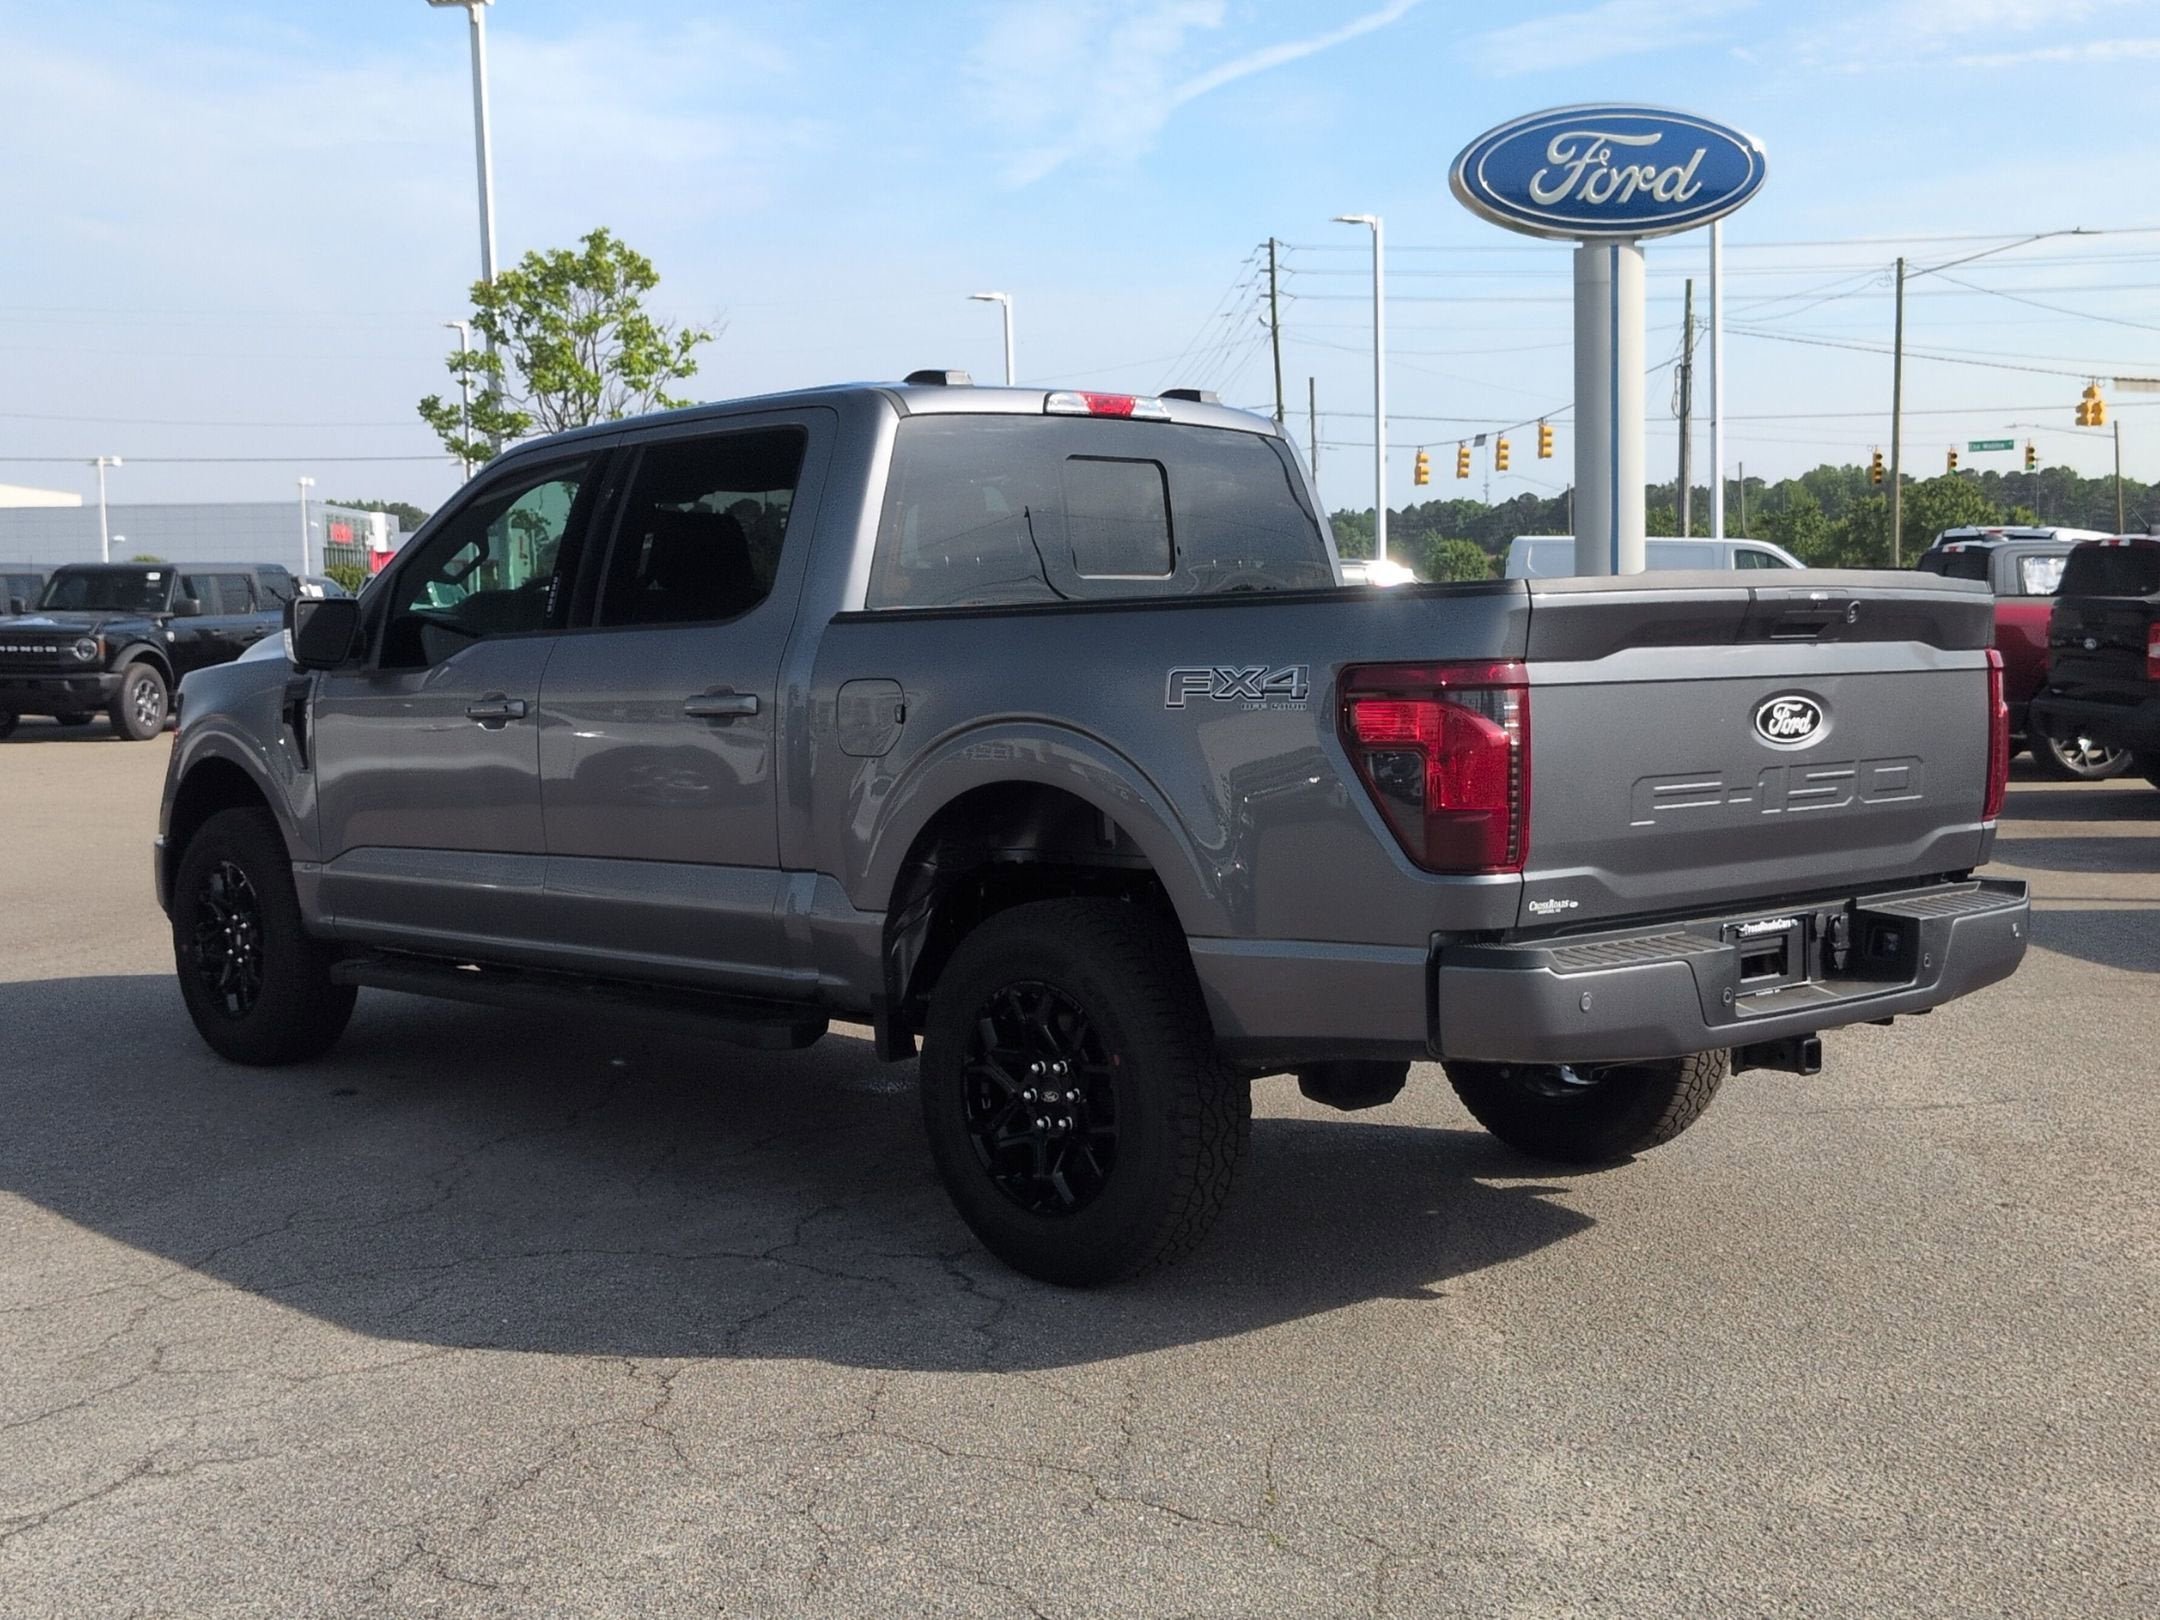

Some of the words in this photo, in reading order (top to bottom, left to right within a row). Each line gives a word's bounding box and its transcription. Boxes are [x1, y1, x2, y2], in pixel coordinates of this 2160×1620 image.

[1529, 130, 1706, 205] Ford
[1165, 664, 1309, 709] FX4
[1768, 703, 1813, 735] Ford
[1631, 755, 1923, 826] F-150
